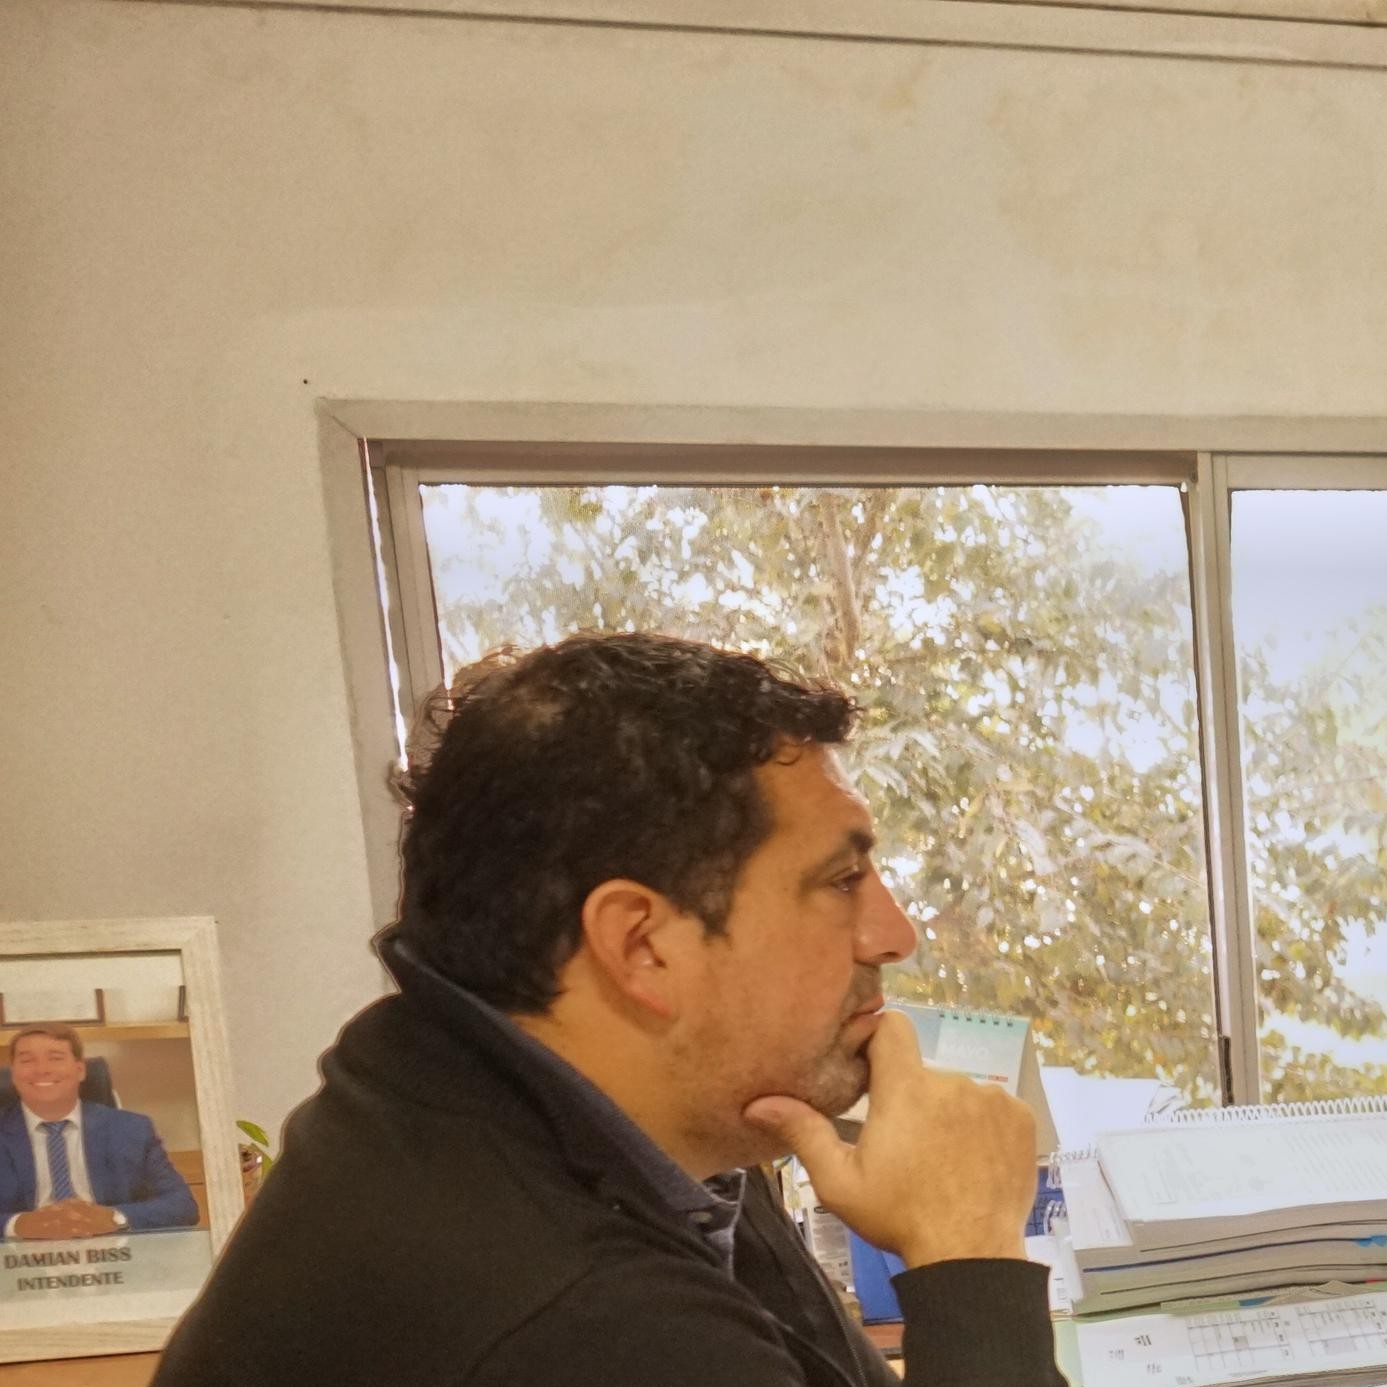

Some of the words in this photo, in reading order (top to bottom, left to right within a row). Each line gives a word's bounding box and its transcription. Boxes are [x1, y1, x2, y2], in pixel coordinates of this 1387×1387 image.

[4, 1250, 81, 1269] DAMIAN
[86, 1247, 132, 1264] BISS
[17, 1271, 125, 1291] INTENDENTE
